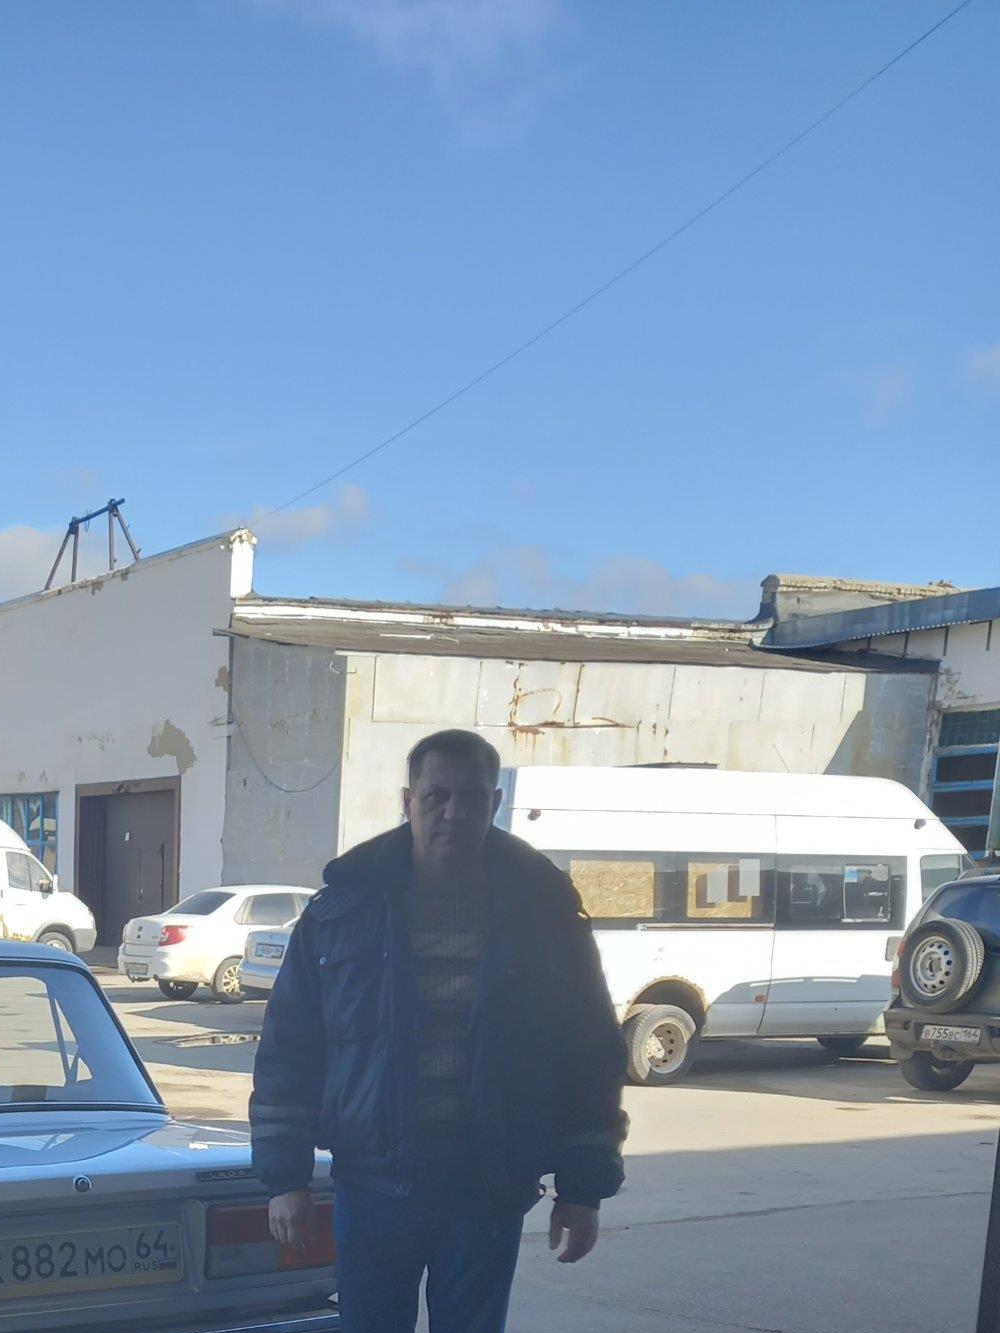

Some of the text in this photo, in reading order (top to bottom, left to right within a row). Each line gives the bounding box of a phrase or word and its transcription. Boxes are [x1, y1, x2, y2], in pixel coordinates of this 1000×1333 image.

[209, 1169, 248, 1178] LADA
[136, 1230, 169, 1259] 64
[134, 1260, 159, 1272] RUS
